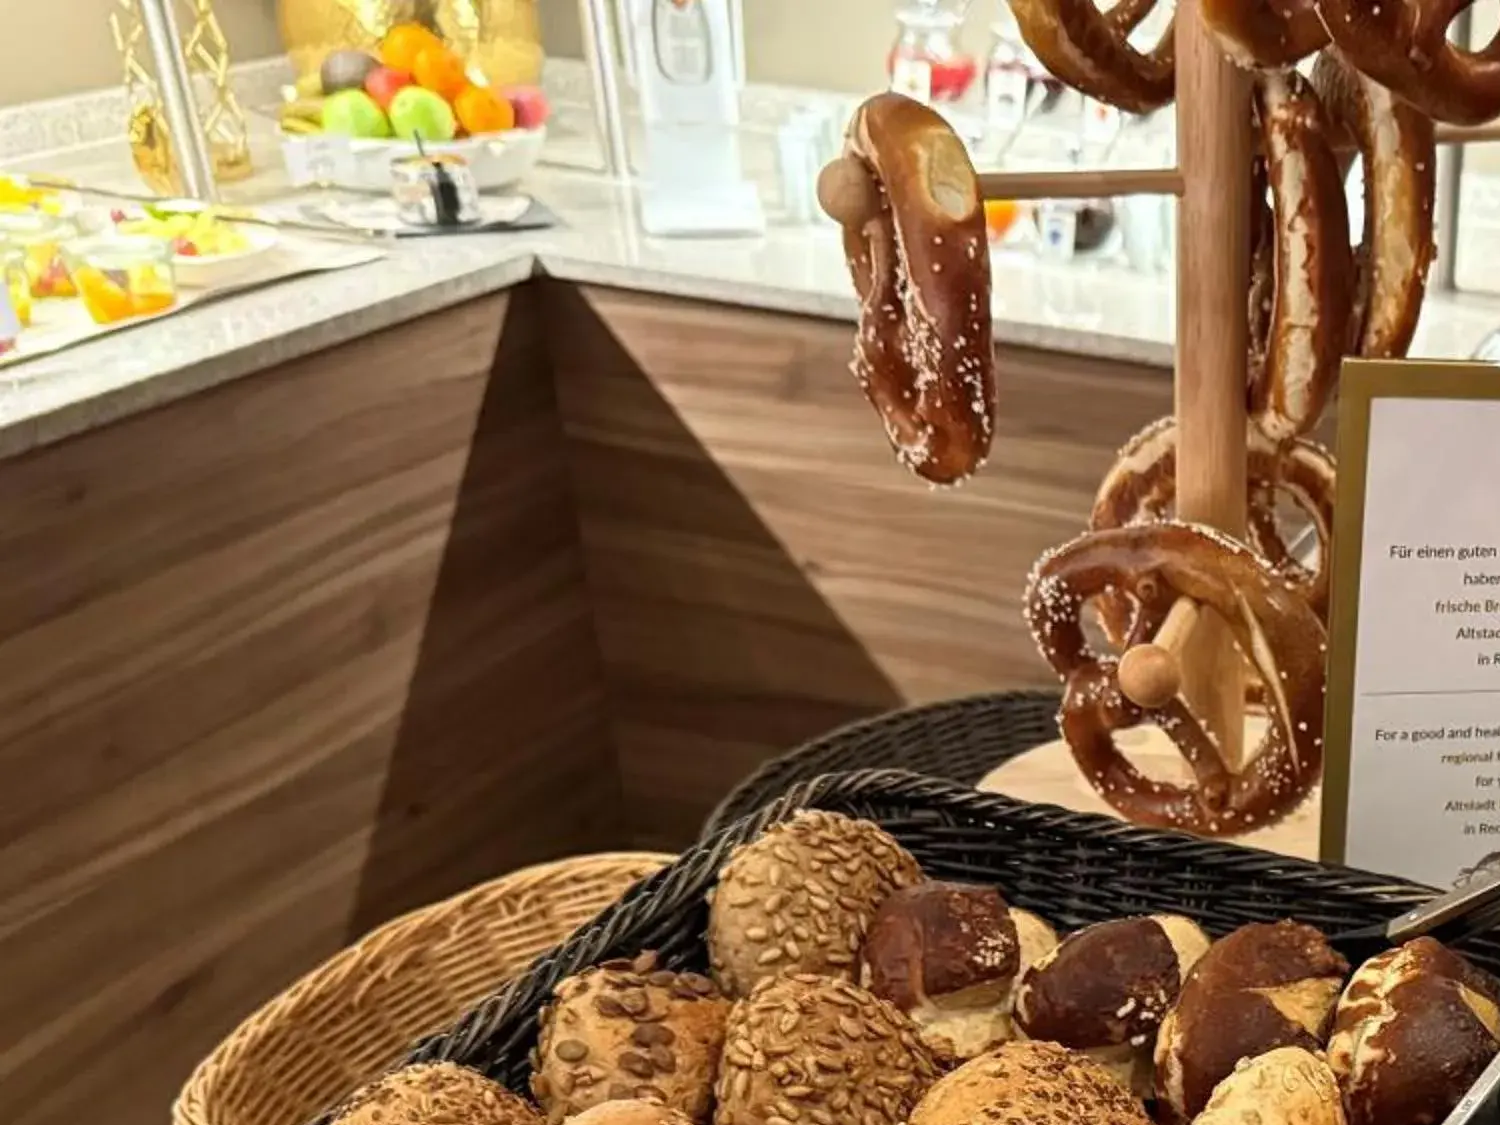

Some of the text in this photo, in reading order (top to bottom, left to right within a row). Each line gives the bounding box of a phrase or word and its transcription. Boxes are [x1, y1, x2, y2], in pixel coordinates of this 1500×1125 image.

[1389, 544, 1413, 559] Für
[1417, 544, 1455, 559] einen
[1457, 545, 1497, 560] guten
[1435, 599, 1481, 614] frische
[1477, 652, 1490, 666] in
[1375, 728, 1399, 741] For
[1400, 730, 1409, 740] a
[1411, 727, 1445, 743] good
[1447, 726, 1472, 740] and
[1440, 751, 1493, 765] regional
[1475, 774, 1494, 787] for
